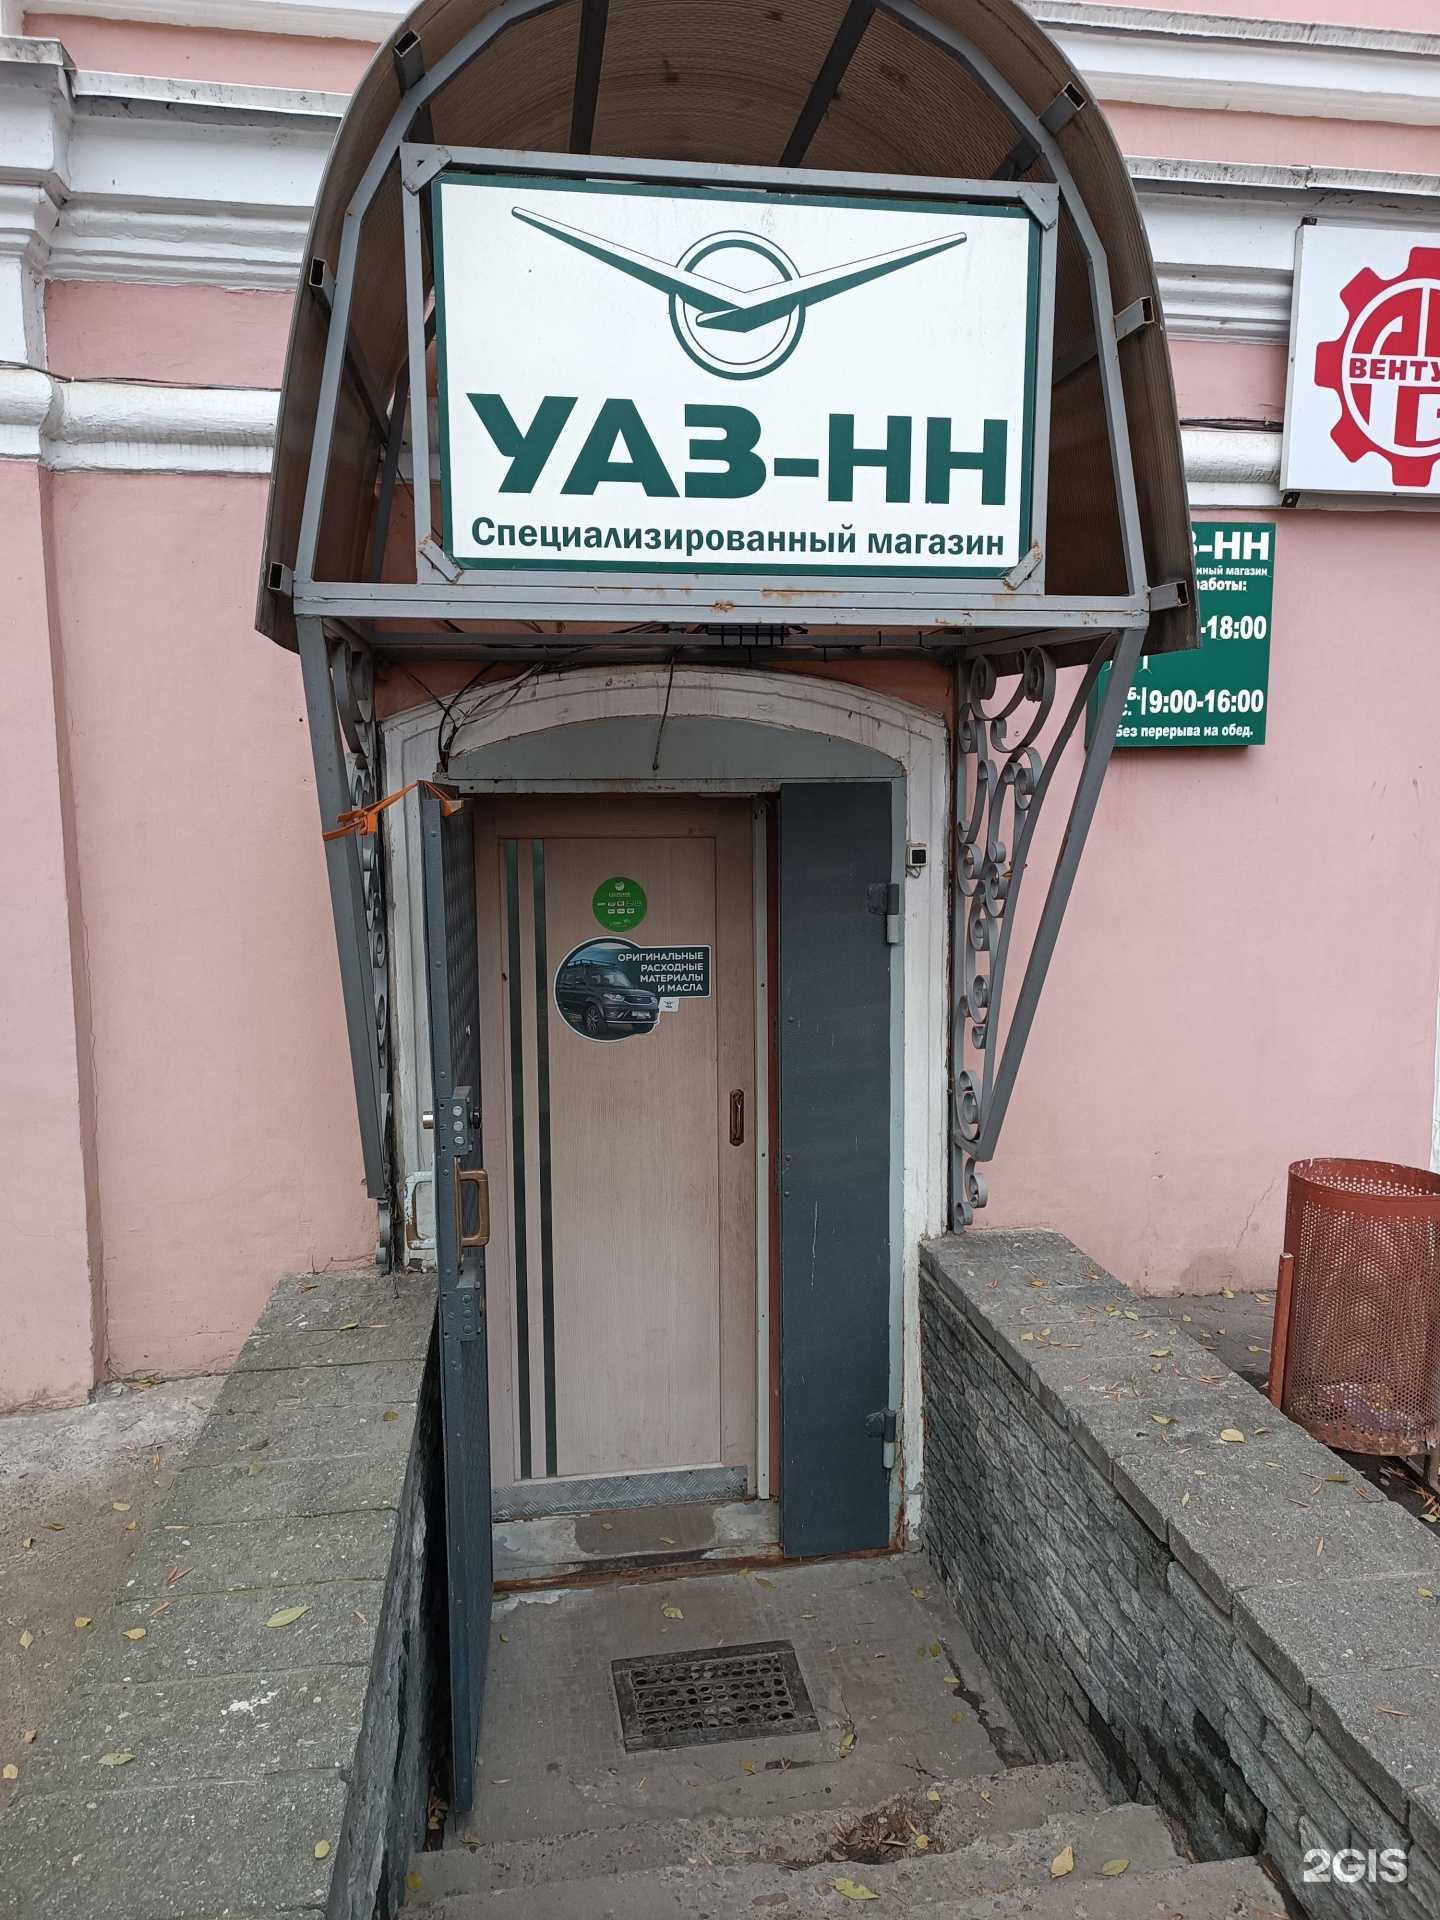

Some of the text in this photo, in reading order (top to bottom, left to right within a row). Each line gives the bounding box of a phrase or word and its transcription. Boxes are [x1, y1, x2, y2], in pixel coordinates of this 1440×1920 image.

[465, 392, 1008, 506] УАЗ-НН
[471, 515, 1005, 557] Специализированный магазин
[1191, 531, 1269, 560] -НН
[1225, 567, 1268, 577] магазин
[1149, 689, 1264, 713] 9:00-16:00
[1140, 726, 1201, 740] перерыва
[1203, 726, 1219, 737] на
[1221, 723, 1254, 738] обед.
[617, 951, 704, 962] ОРИГИНАЛЬНЫЕ
[641, 963, 704, 973] РАСХОДНЫЕ
[640, 973, 704, 983] МАТЕРИАЛЫ
[657, 983, 703, 993] И МАСЛА
